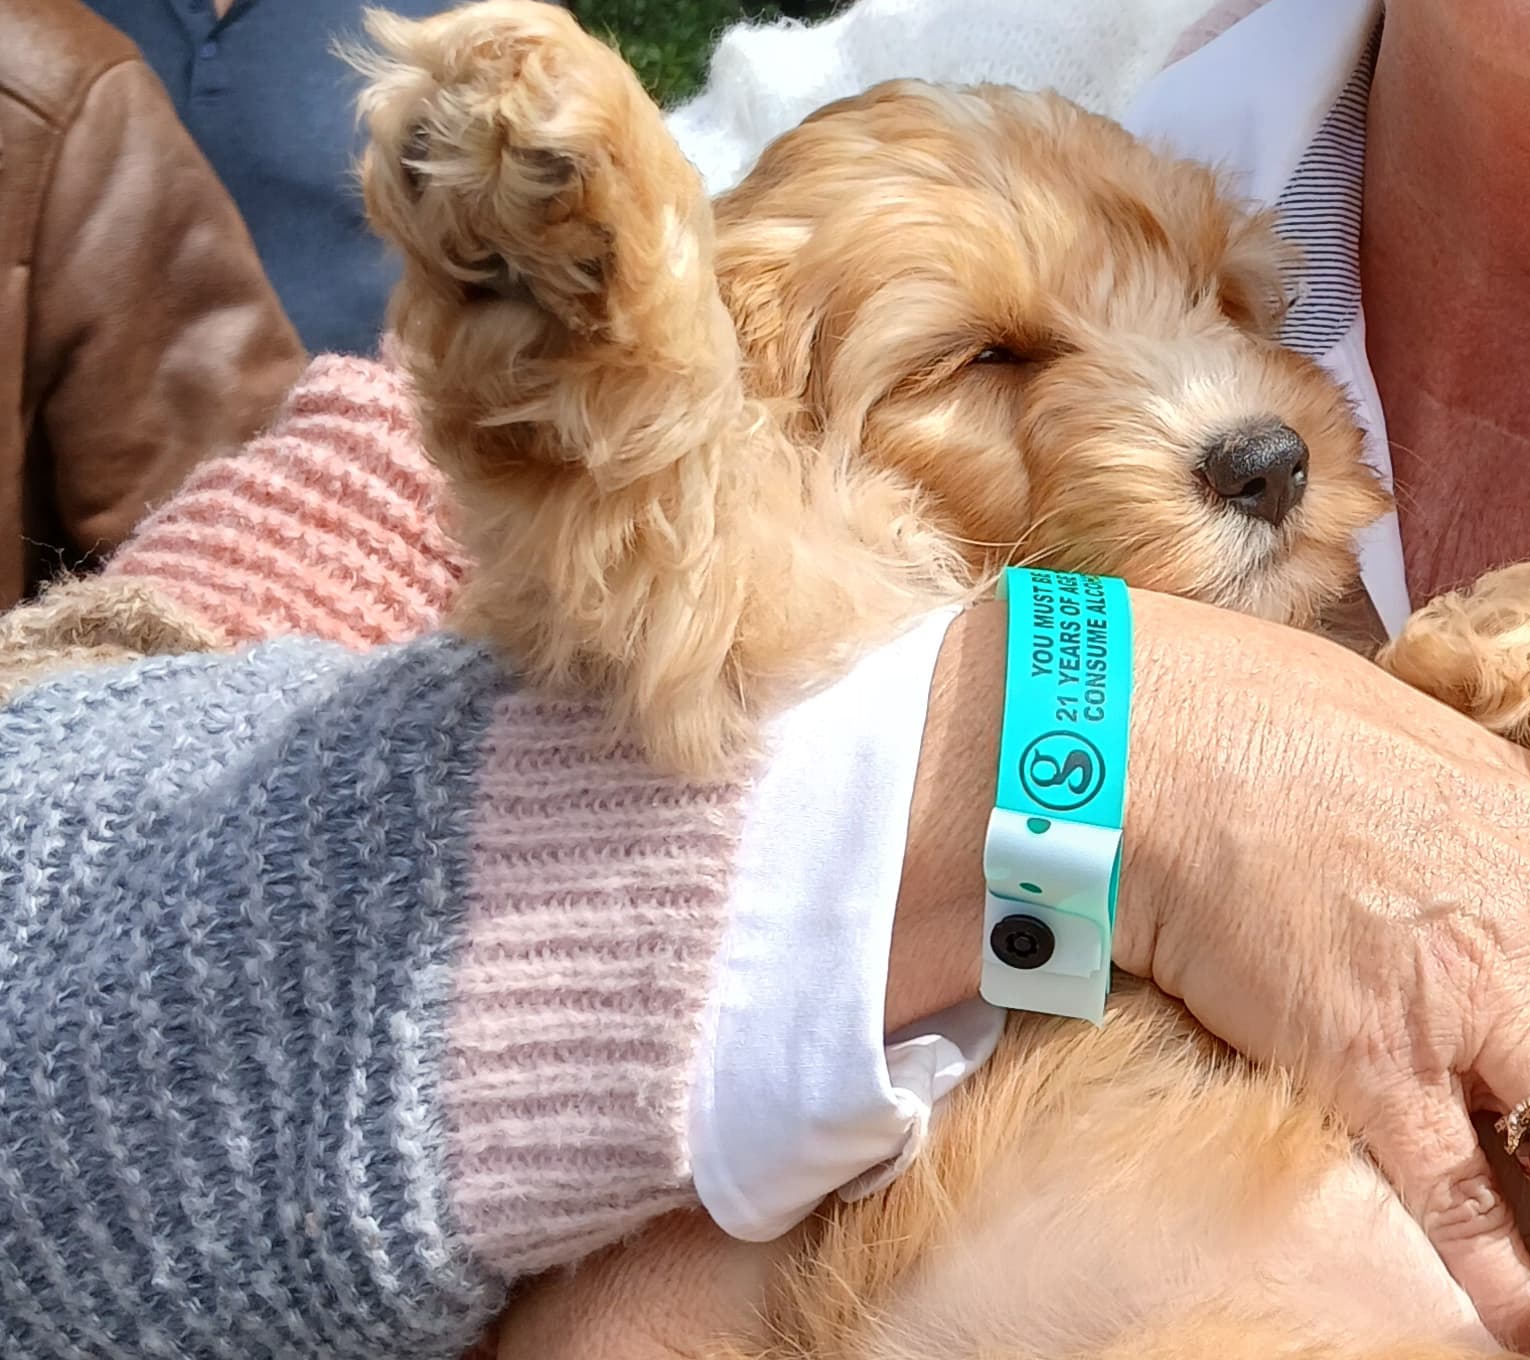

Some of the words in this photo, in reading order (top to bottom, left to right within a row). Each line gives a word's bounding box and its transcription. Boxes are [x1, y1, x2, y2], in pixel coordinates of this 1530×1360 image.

[1030, 572, 1053, 585] BE
[1056, 574, 1081, 595] AGE
[1032, 585, 1055, 629] MUST
[1059, 597, 1081, 616] OF
[1032, 635, 1055, 678] YOU
[1058, 620, 1082, 686] YEARS
[1083, 618, 1108, 722] CONSUME
[1056, 695, 1079, 723] 21
